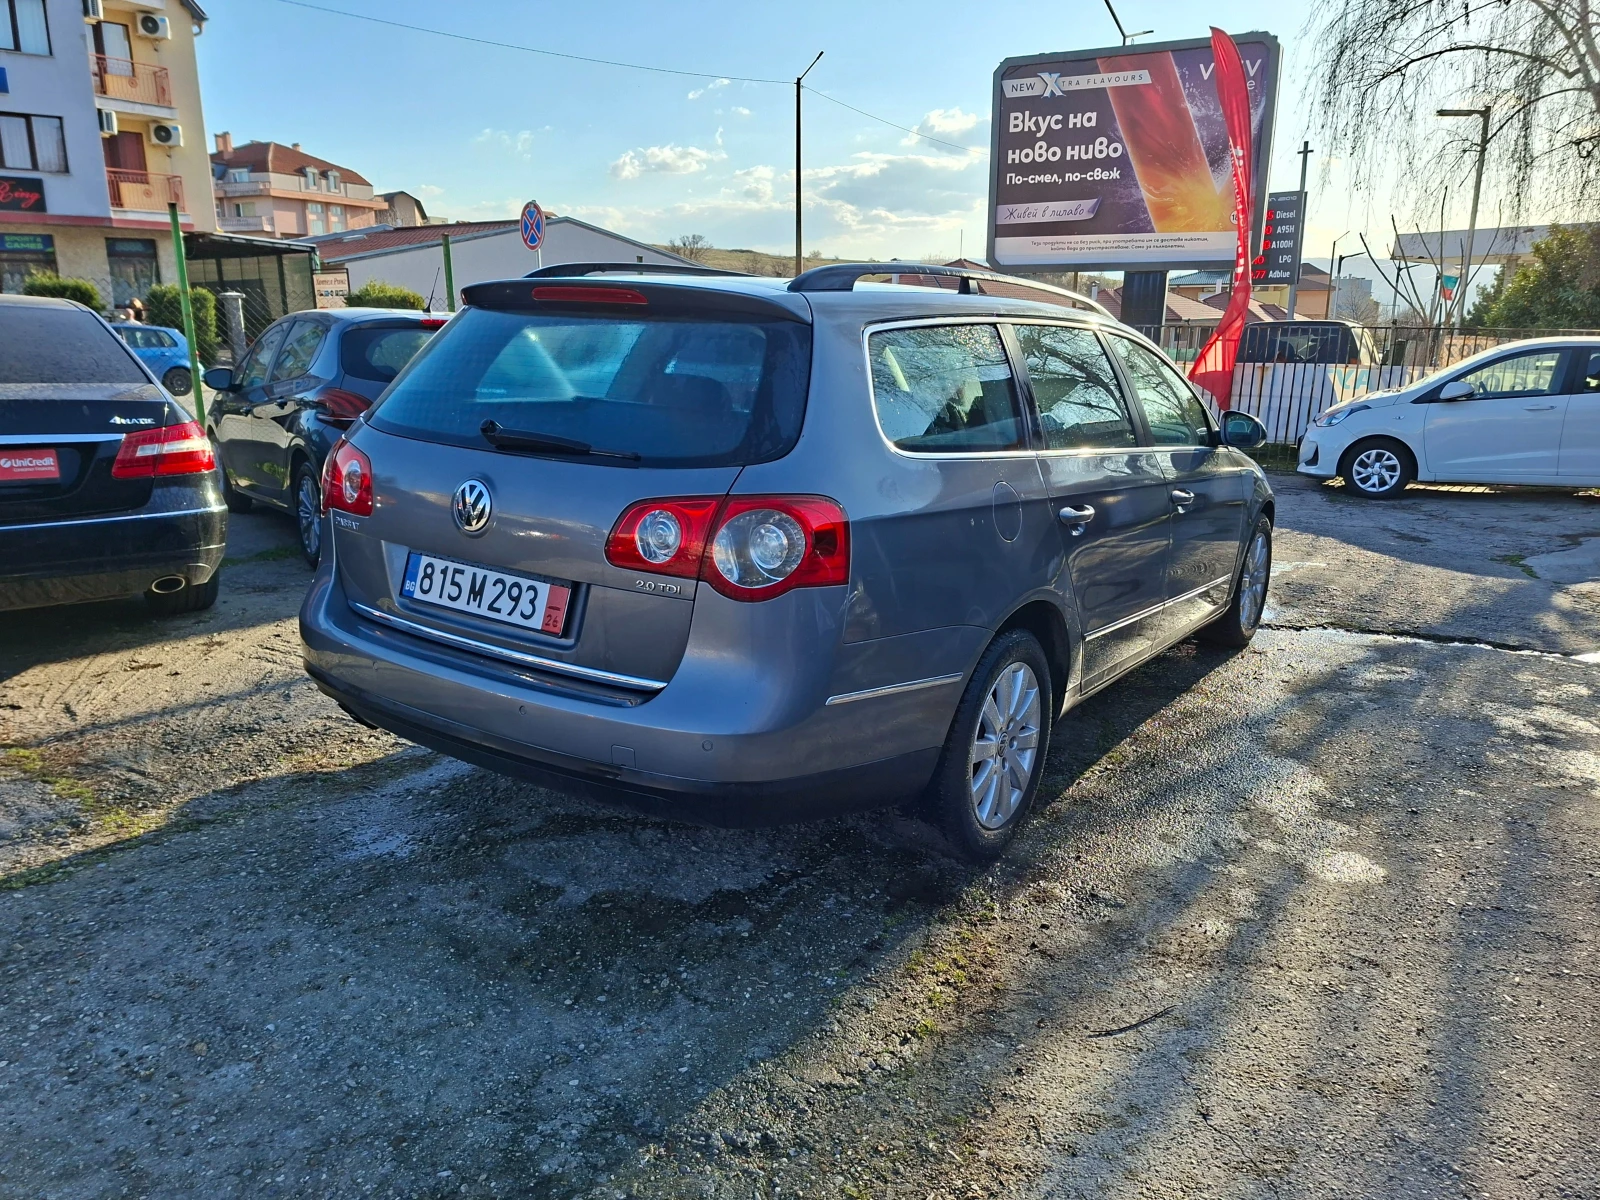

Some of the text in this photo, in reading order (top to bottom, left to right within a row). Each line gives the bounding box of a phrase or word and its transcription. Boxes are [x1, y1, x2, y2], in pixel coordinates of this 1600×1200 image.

[1011, 82, 1036, 93] NEW
[1086, 73, 1144, 86] FLAVOURS
[1008, 110, 1098, 137] Вкус на
[1007, 136, 1123, 164] ново ниво
[1006, 167, 1121, 185] По-смел, по-свеж
[1004, 204, 1085, 220] Живей в лилаво
[1276, 209, 1296, 219] Diesel
[1276, 225, 1295, 234] A95H
[1271, 240, 1293, 249] A100H
[1279, 255, 1292, 263] LPG
[1268, 270, 1291, 279] Adblue
[12, 456, 55, 467] UniCredit
[405, 579, 415, 592] BG
[419, 562, 538, 620] 815M293
[635, 579, 683, 595] 2.0 TDI
[544, 614, 558, 628] 26
